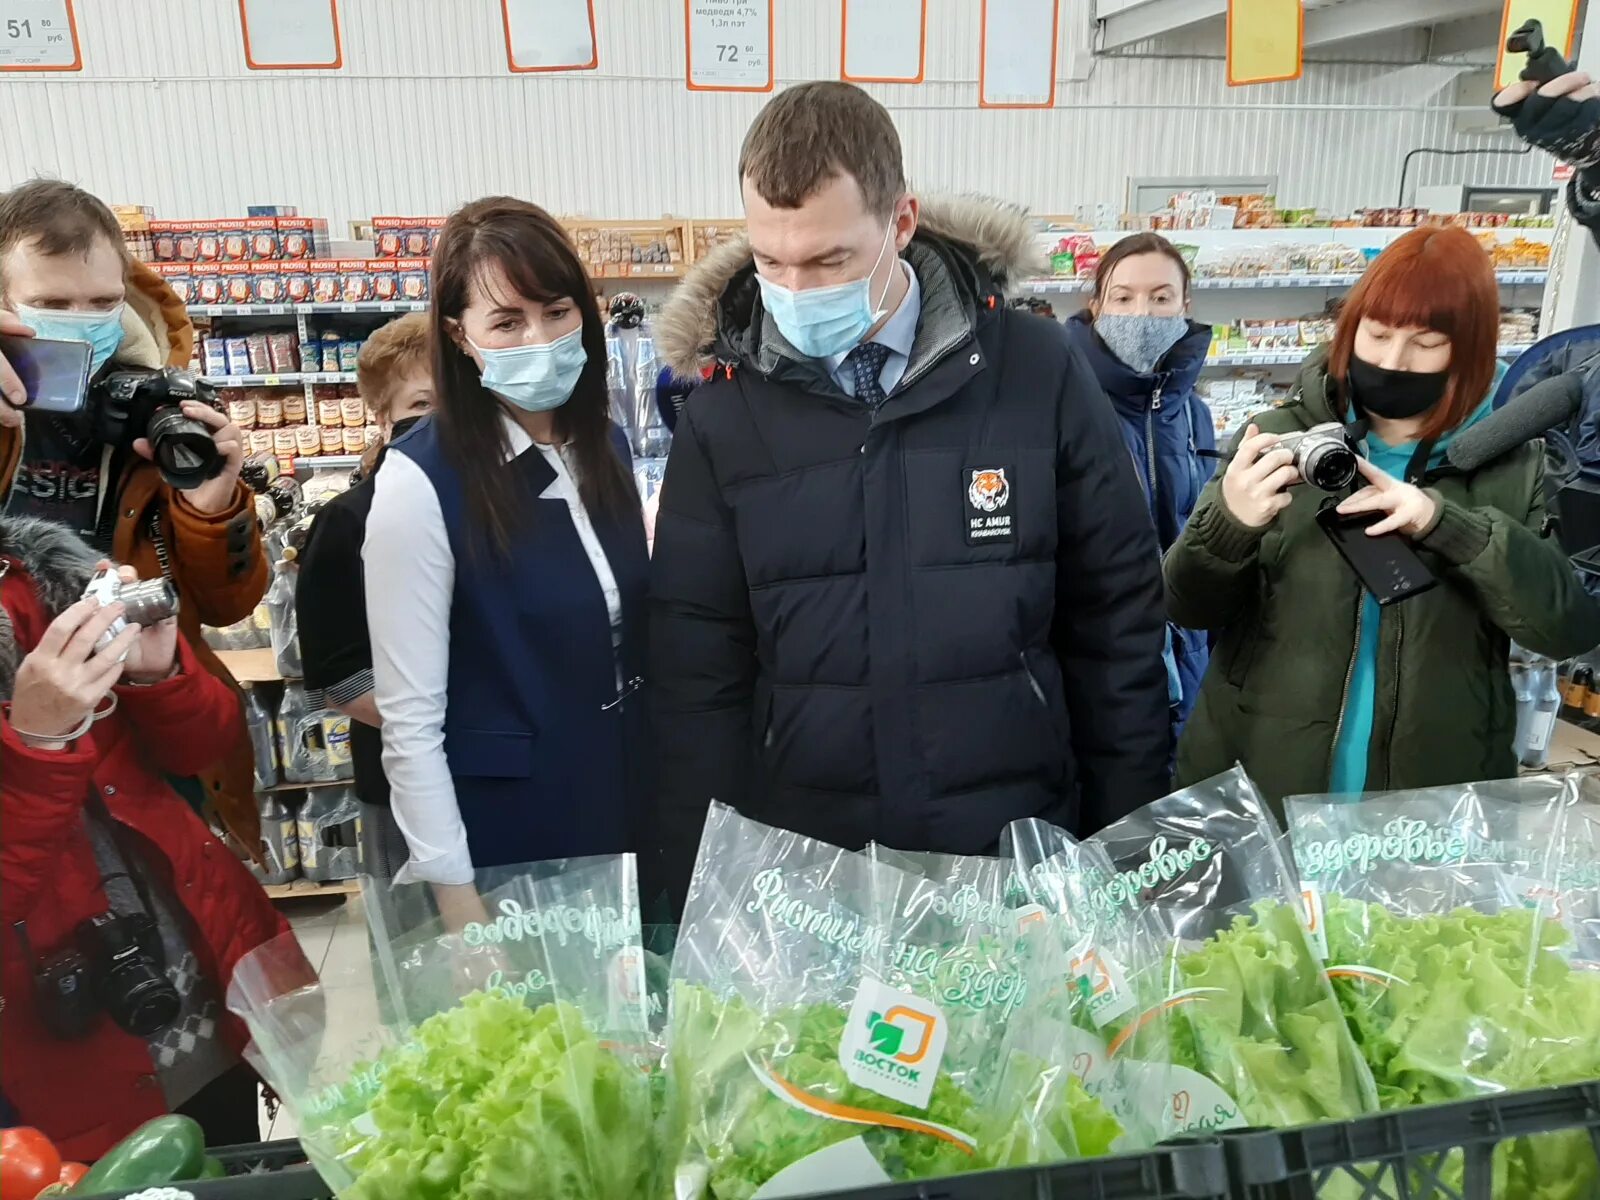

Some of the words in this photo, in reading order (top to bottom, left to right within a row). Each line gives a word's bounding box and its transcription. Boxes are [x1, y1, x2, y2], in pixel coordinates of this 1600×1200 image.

[695, 8, 735, 17] медведя
[736, 8, 758, 18] 4,7%
[7, 19, 32, 38] 51
[41, 19, 51, 27] 80
[711, 18, 729, 28] 1,3л
[47, 33, 66, 43] руб.
[716, 44, 739, 62] 72
[374, 219, 400, 227] PROSTO
[368, 261, 395, 269] PROSTO
[970, 518, 984, 528] HC
[985, 515, 1011, 528] AMUR
[893, 943, 940, 977] на
[853, 1049, 920, 1082] ВОСТОК
